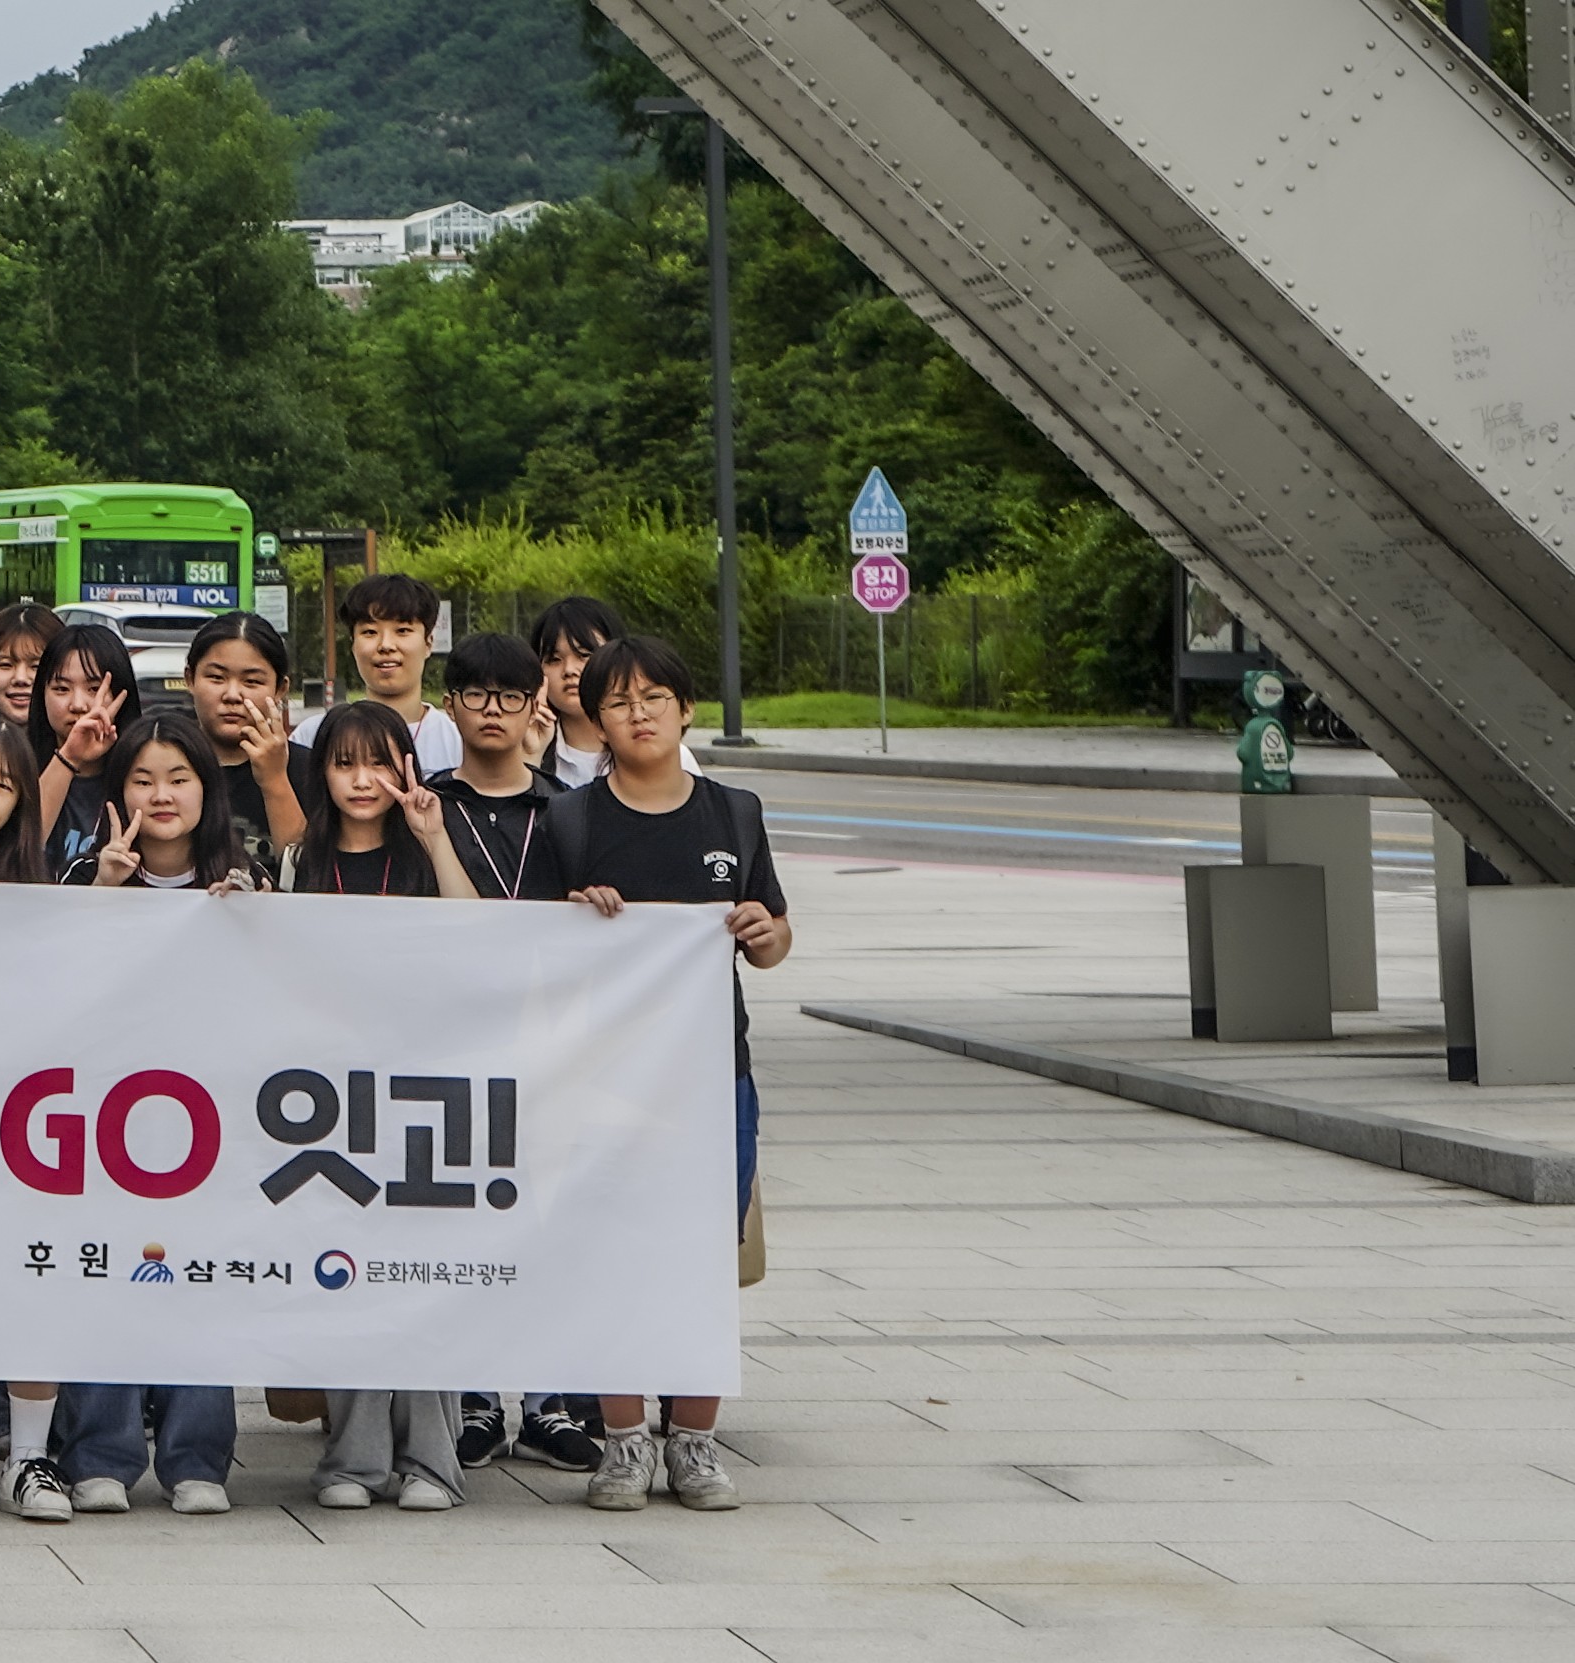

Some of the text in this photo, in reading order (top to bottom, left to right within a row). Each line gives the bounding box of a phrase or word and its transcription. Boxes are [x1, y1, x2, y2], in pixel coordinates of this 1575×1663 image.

[188, 563, 227, 584] 5511
[862, 565, 898, 586] 정지
[193, 588, 230, 605] NOL
[864, 587, 898, 600] STOP
[0, 1067, 221, 1199] GO
[256, 1069, 518, 1210] 잇고!
[184, 1259, 292, 1285] 삼척시
[366, 1261, 517, 1287] 문화체육관광부
